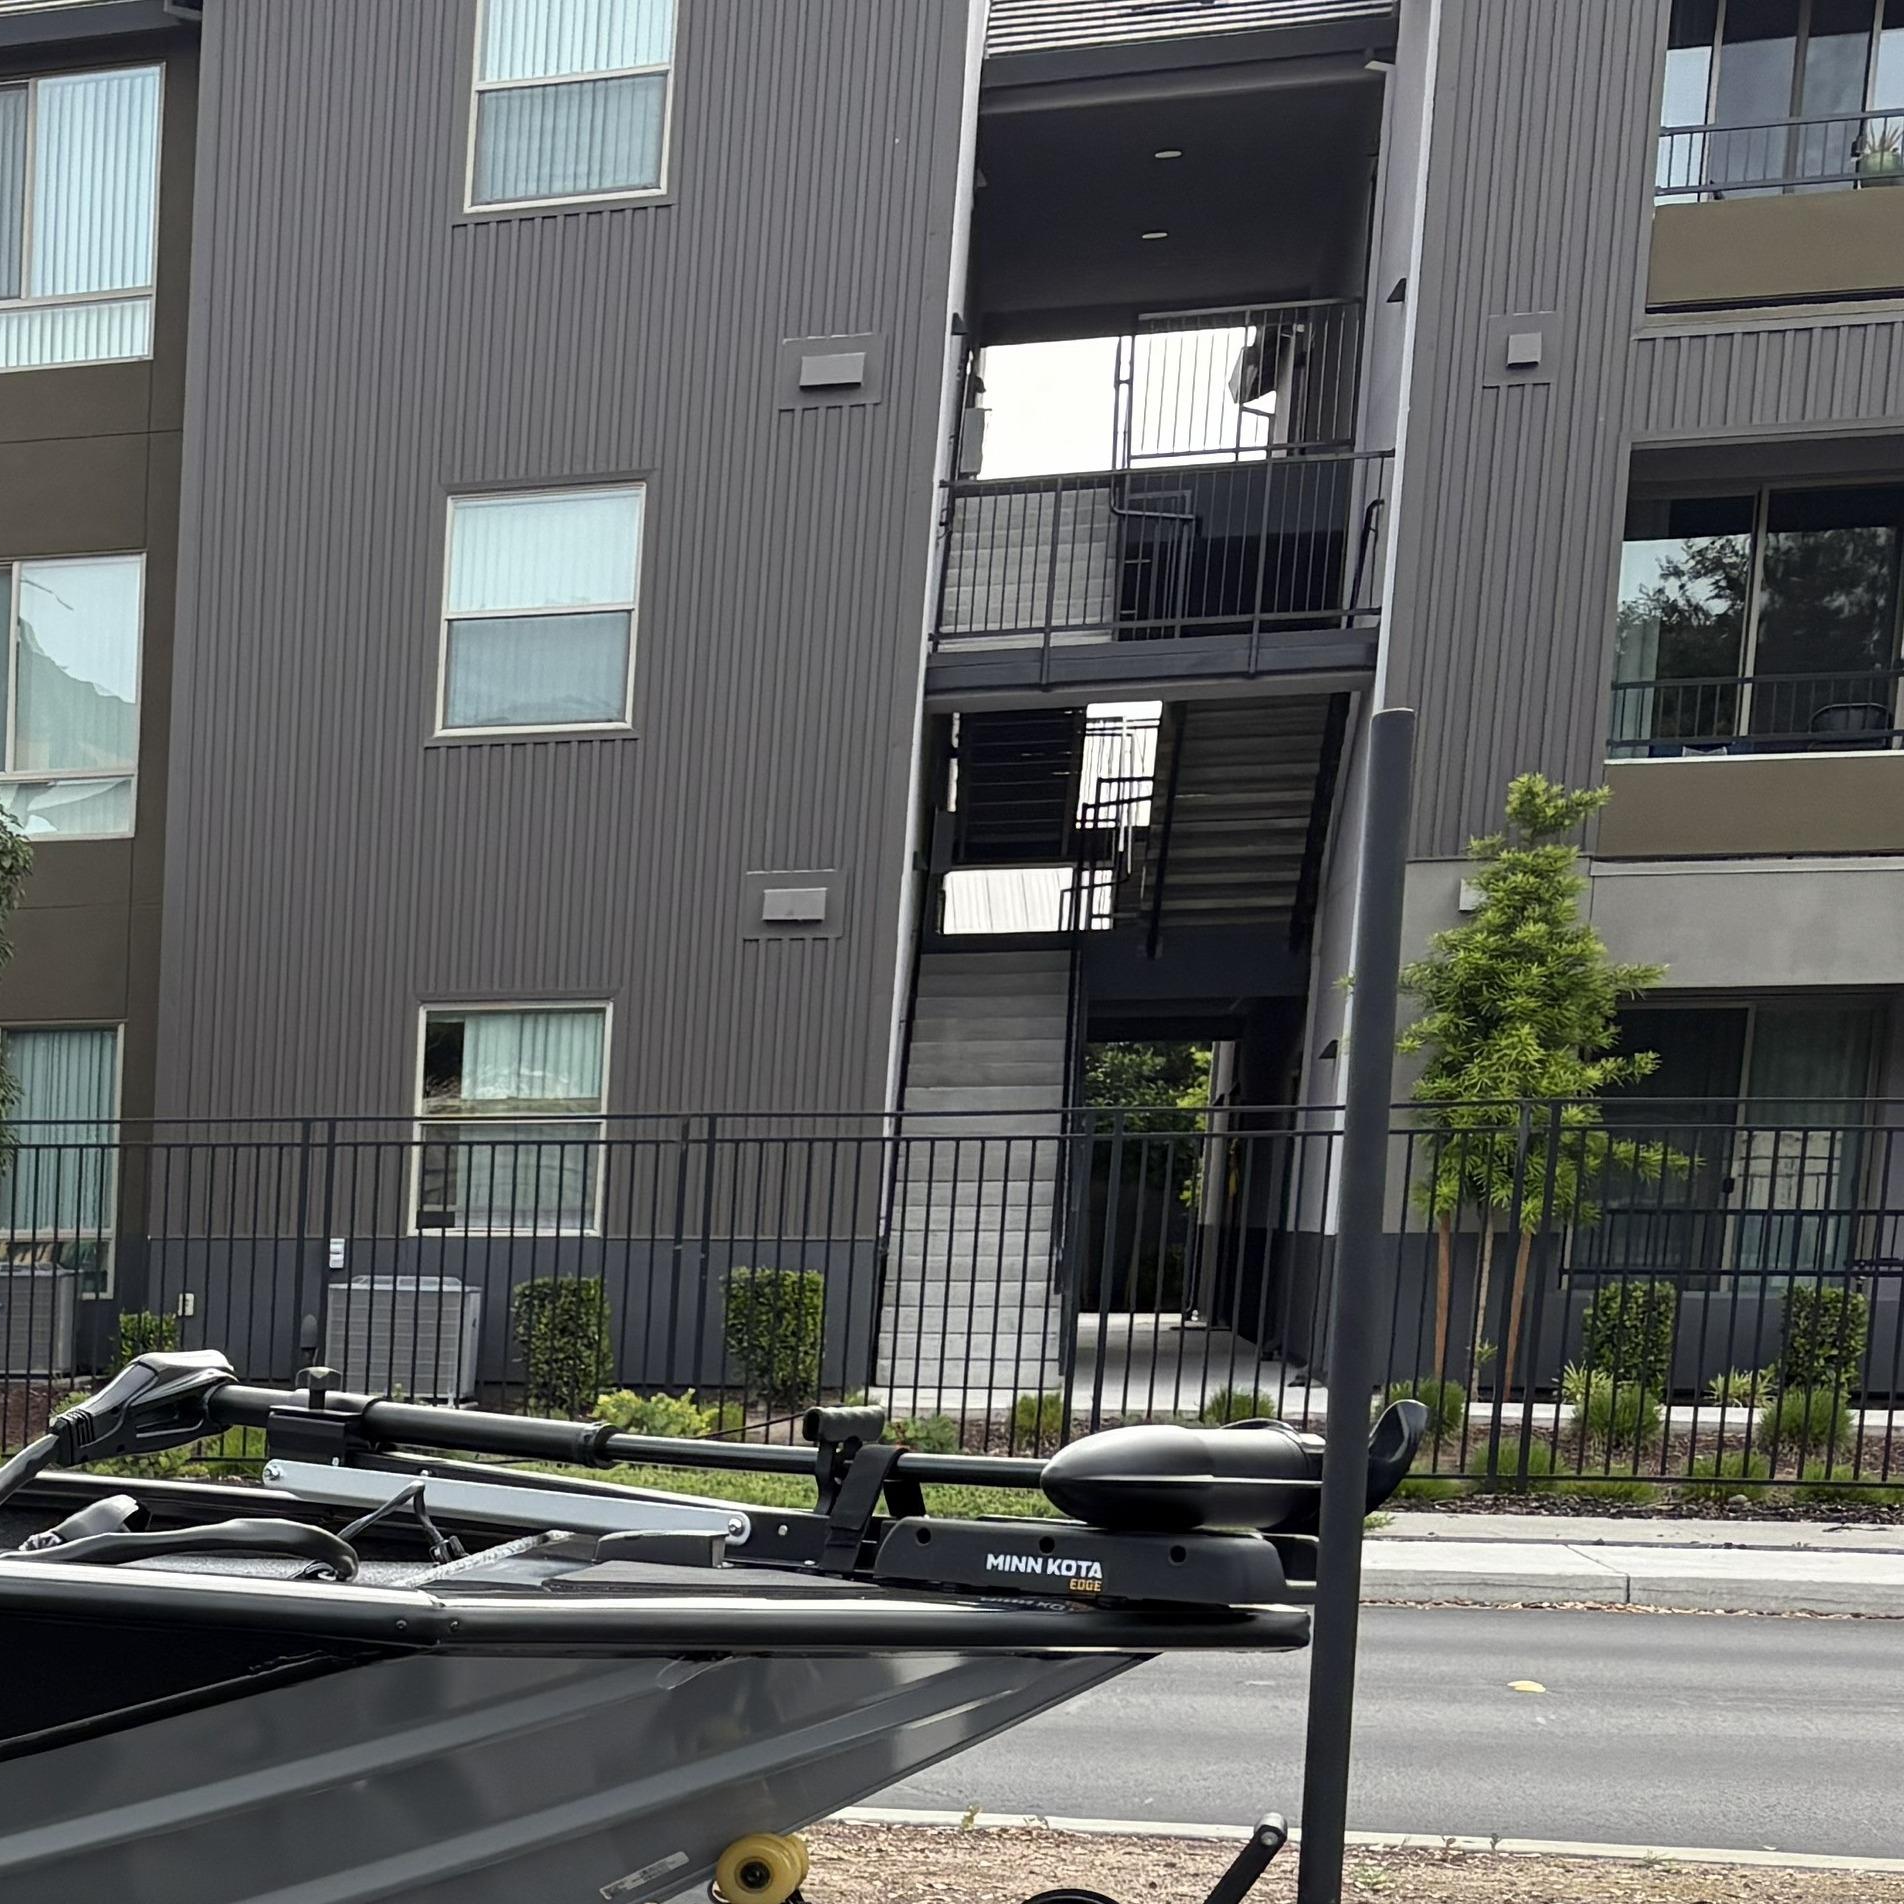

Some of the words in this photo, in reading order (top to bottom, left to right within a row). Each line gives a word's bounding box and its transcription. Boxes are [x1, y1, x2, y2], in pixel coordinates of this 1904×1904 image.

[986, 1553, 1043, 1574] MINN
[1046, 1558, 1103, 1579] KOTA
[1069, 1578, 1102, 1592] EDGE
